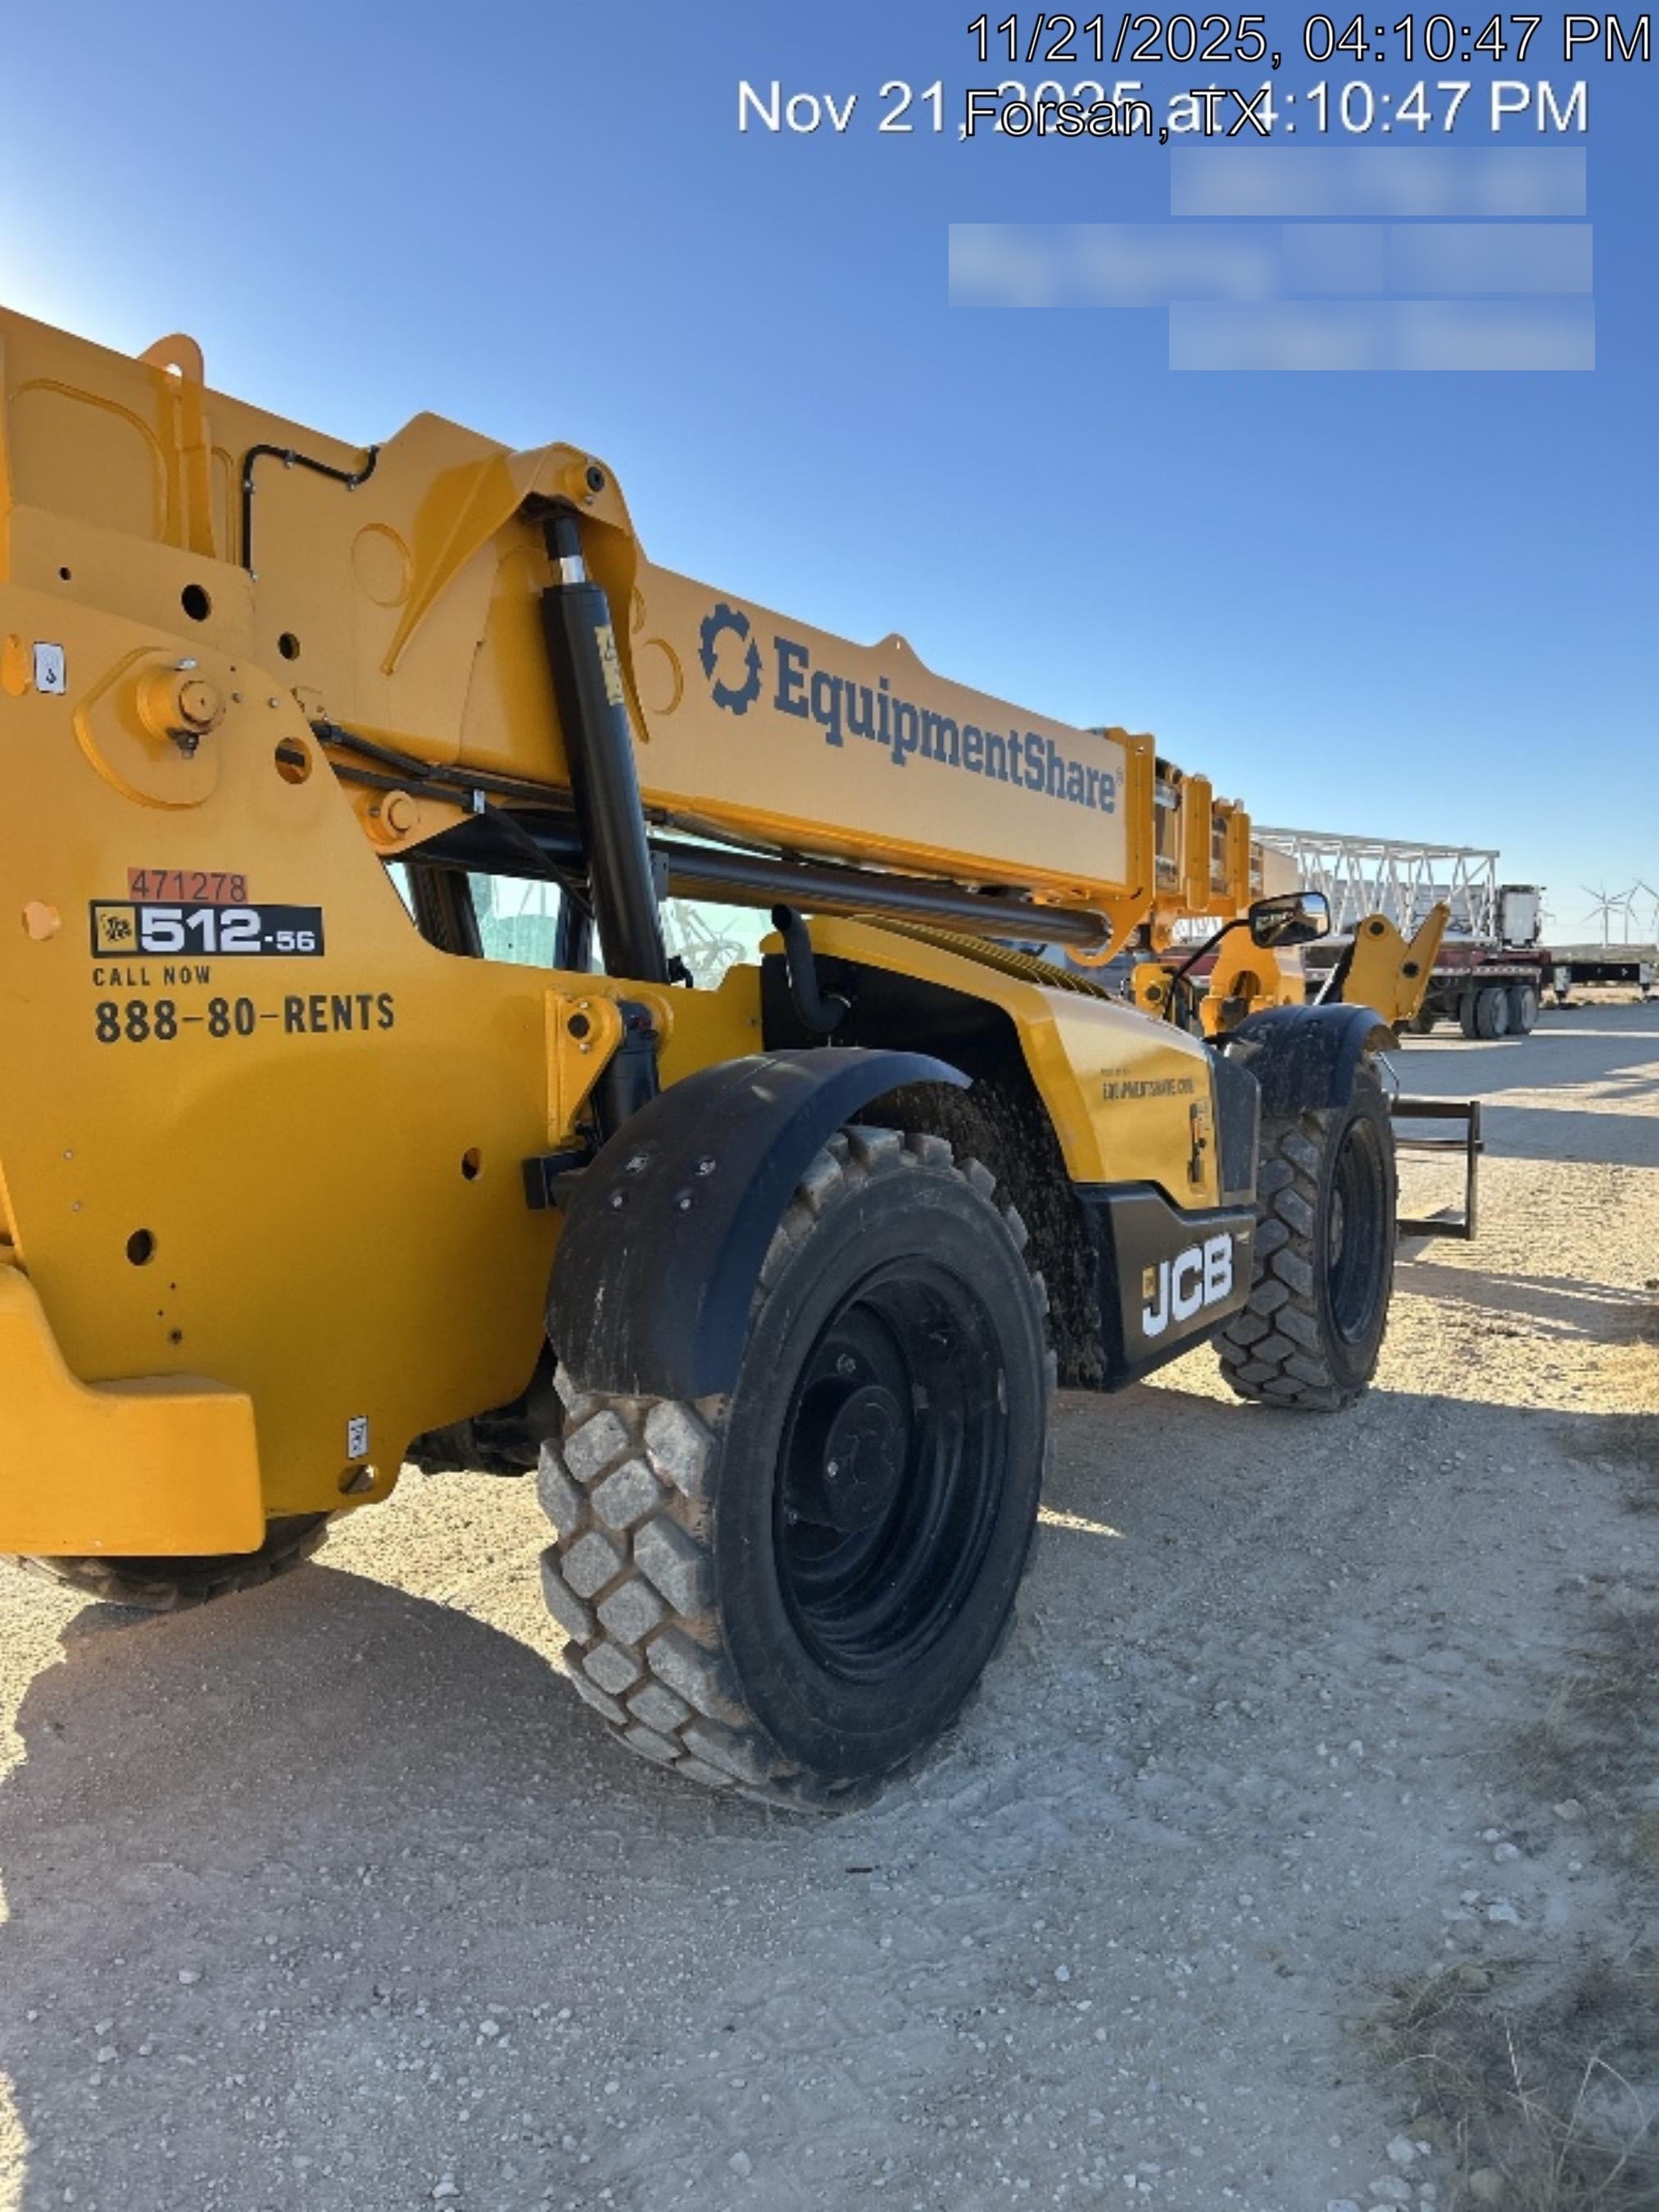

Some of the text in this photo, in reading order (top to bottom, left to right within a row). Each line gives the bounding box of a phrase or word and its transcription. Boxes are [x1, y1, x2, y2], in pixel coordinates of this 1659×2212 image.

[773, 635, 1117, 814] EquipmentShare
[131, 870, 246, 901] 471278
[93, 965, 211, 987] CALL NOW
[95, 992, 395, 1044] 888-80-RENTS
[1142, 1232, 1233, 1338] JCB
